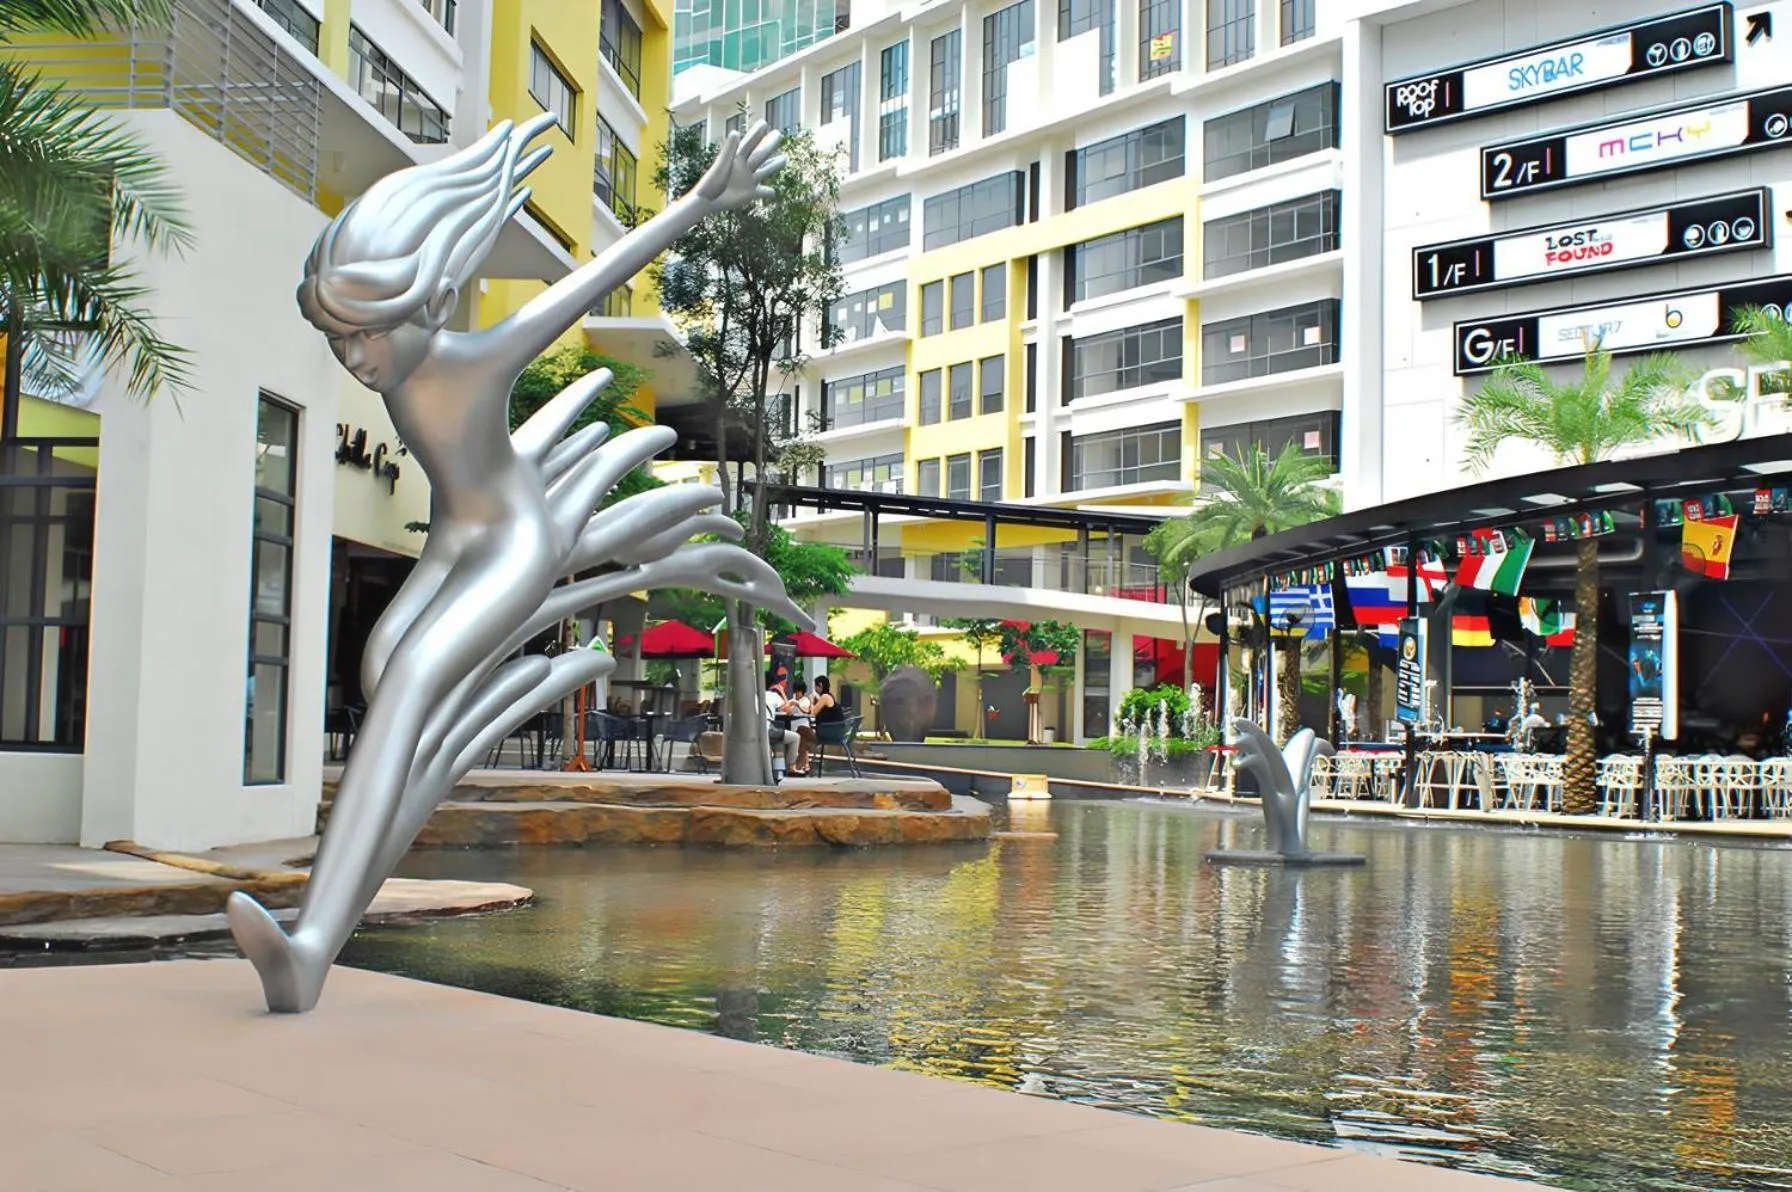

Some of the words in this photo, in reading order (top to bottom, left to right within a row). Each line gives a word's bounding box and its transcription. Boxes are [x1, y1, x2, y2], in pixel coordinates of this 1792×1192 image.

[1508, 52, 1584, 91] SKYBAR
[1493, 152, 1540, 189] 2/F
[1545, 229, 1598, 250] LOST
[1545, 242, 1614, 266] FOUND
[1427, 253, 1466, 288] 1/F
[1463, 327, 1515, 364] G/F
